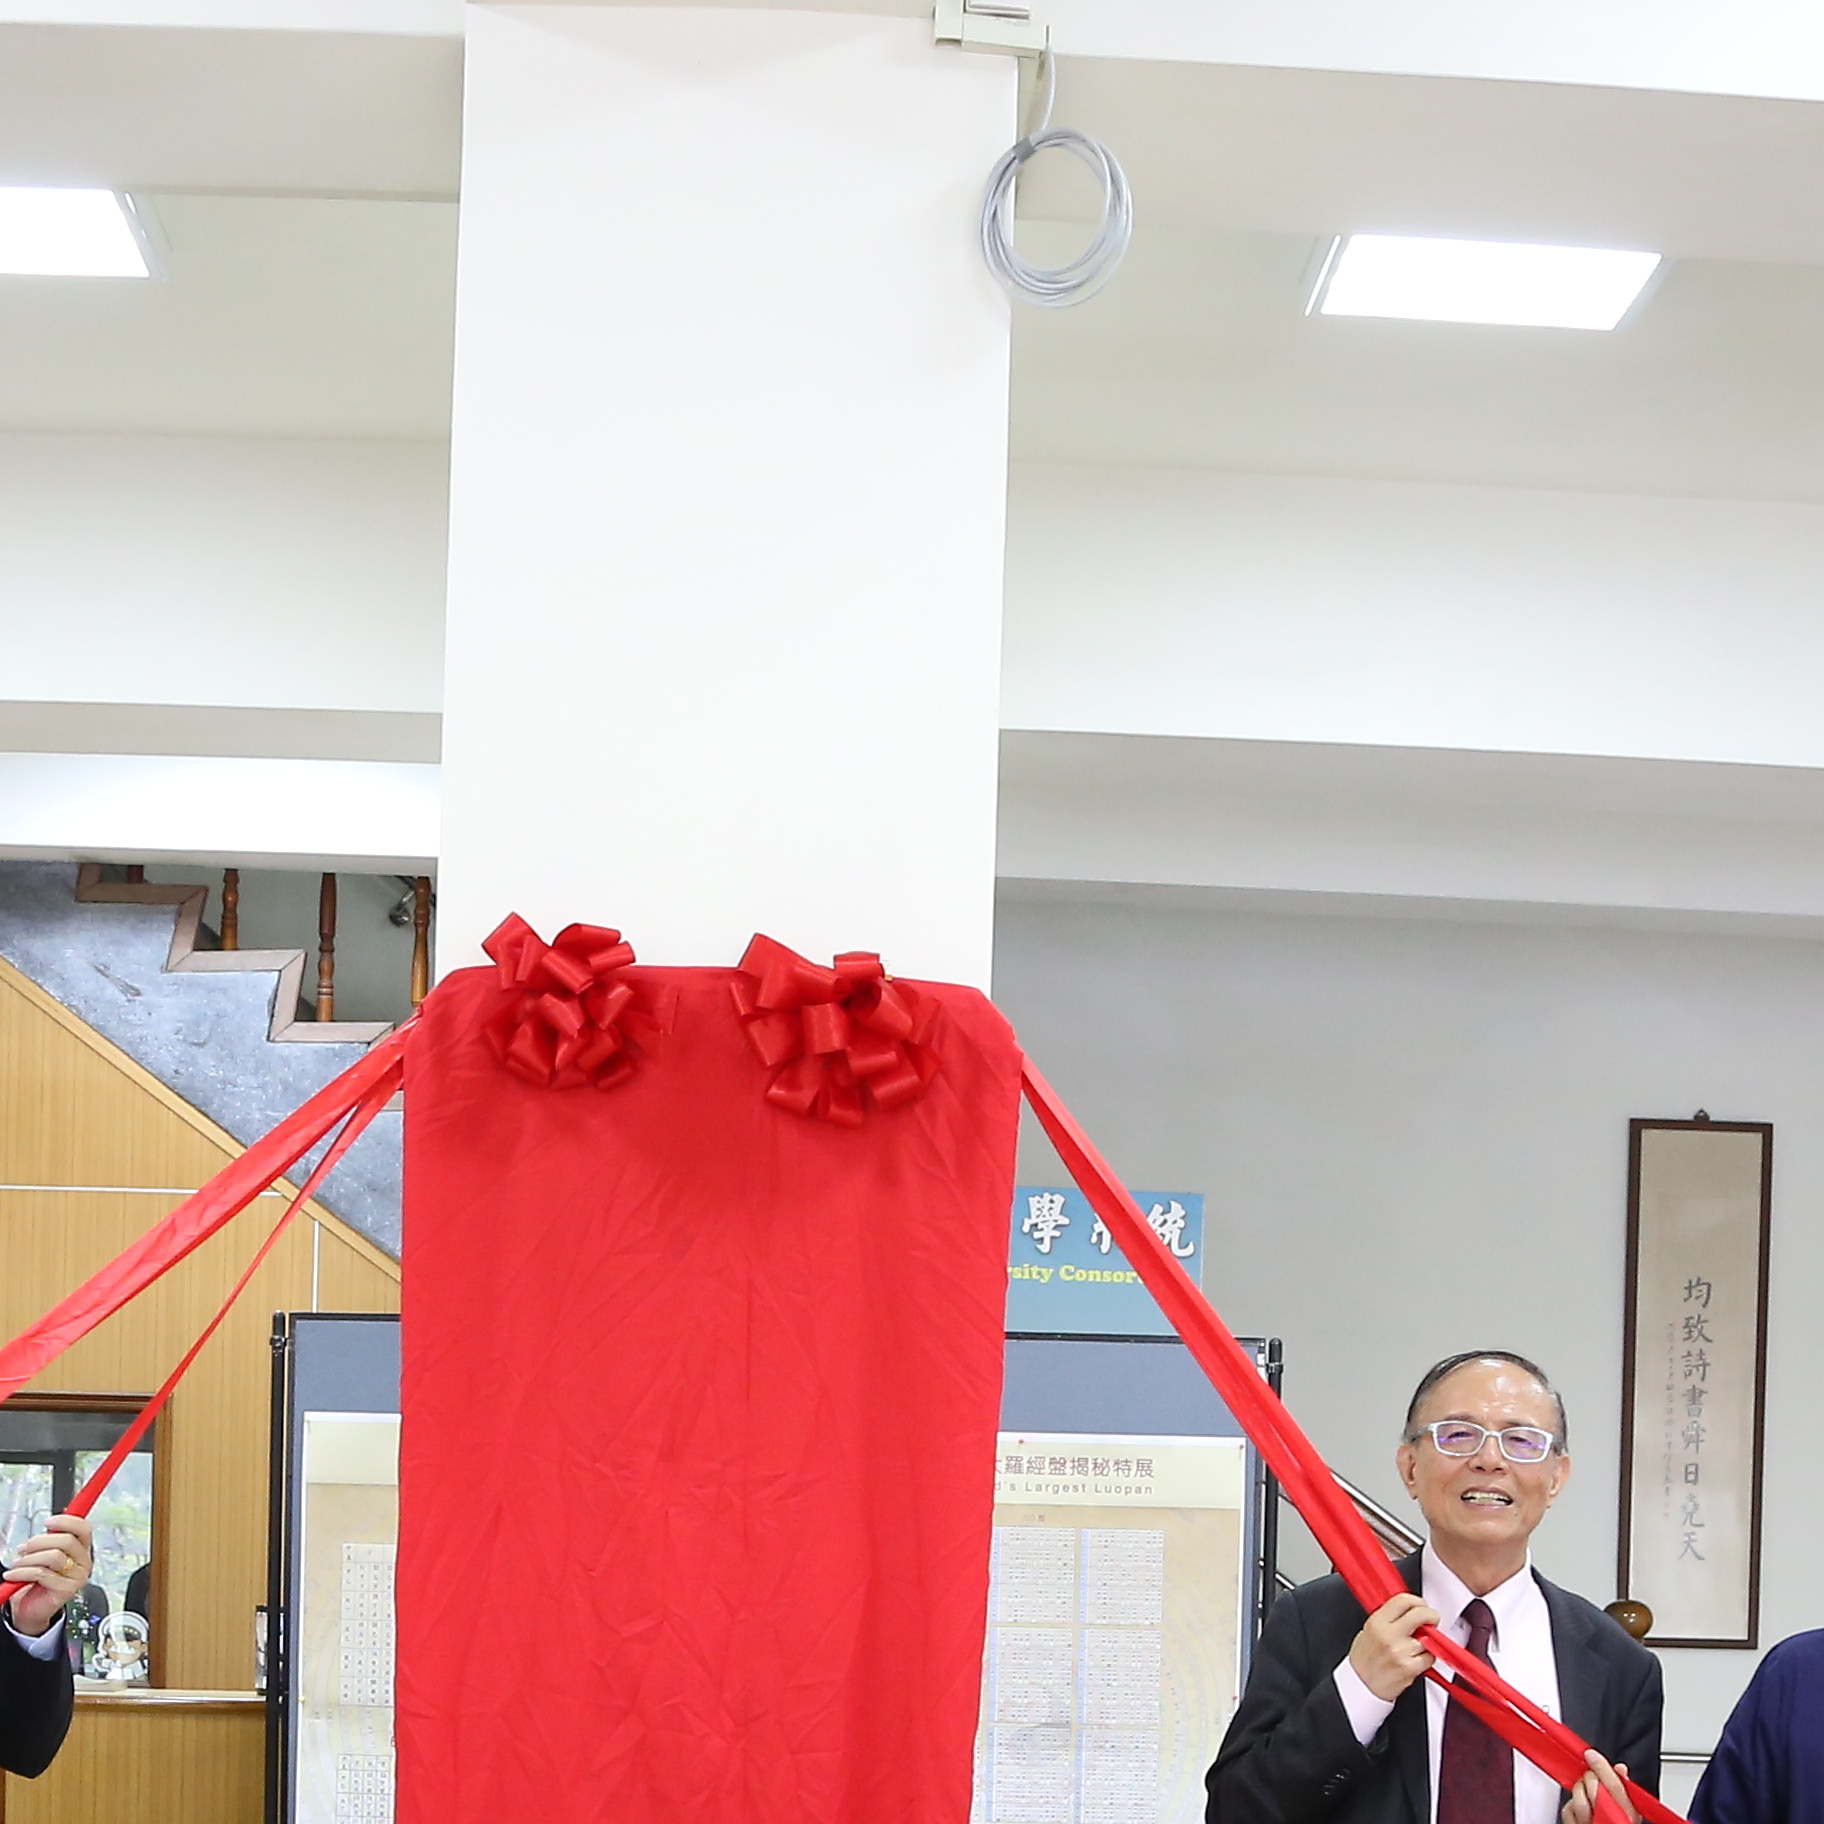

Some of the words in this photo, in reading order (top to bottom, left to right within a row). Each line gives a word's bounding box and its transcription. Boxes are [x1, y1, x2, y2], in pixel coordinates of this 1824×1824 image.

[1059, 1264, 1143, 1284] Consor
[1025, 1481, 1087, 1495] Largest
[1094, 1481, 1153, 1496] Luopan
